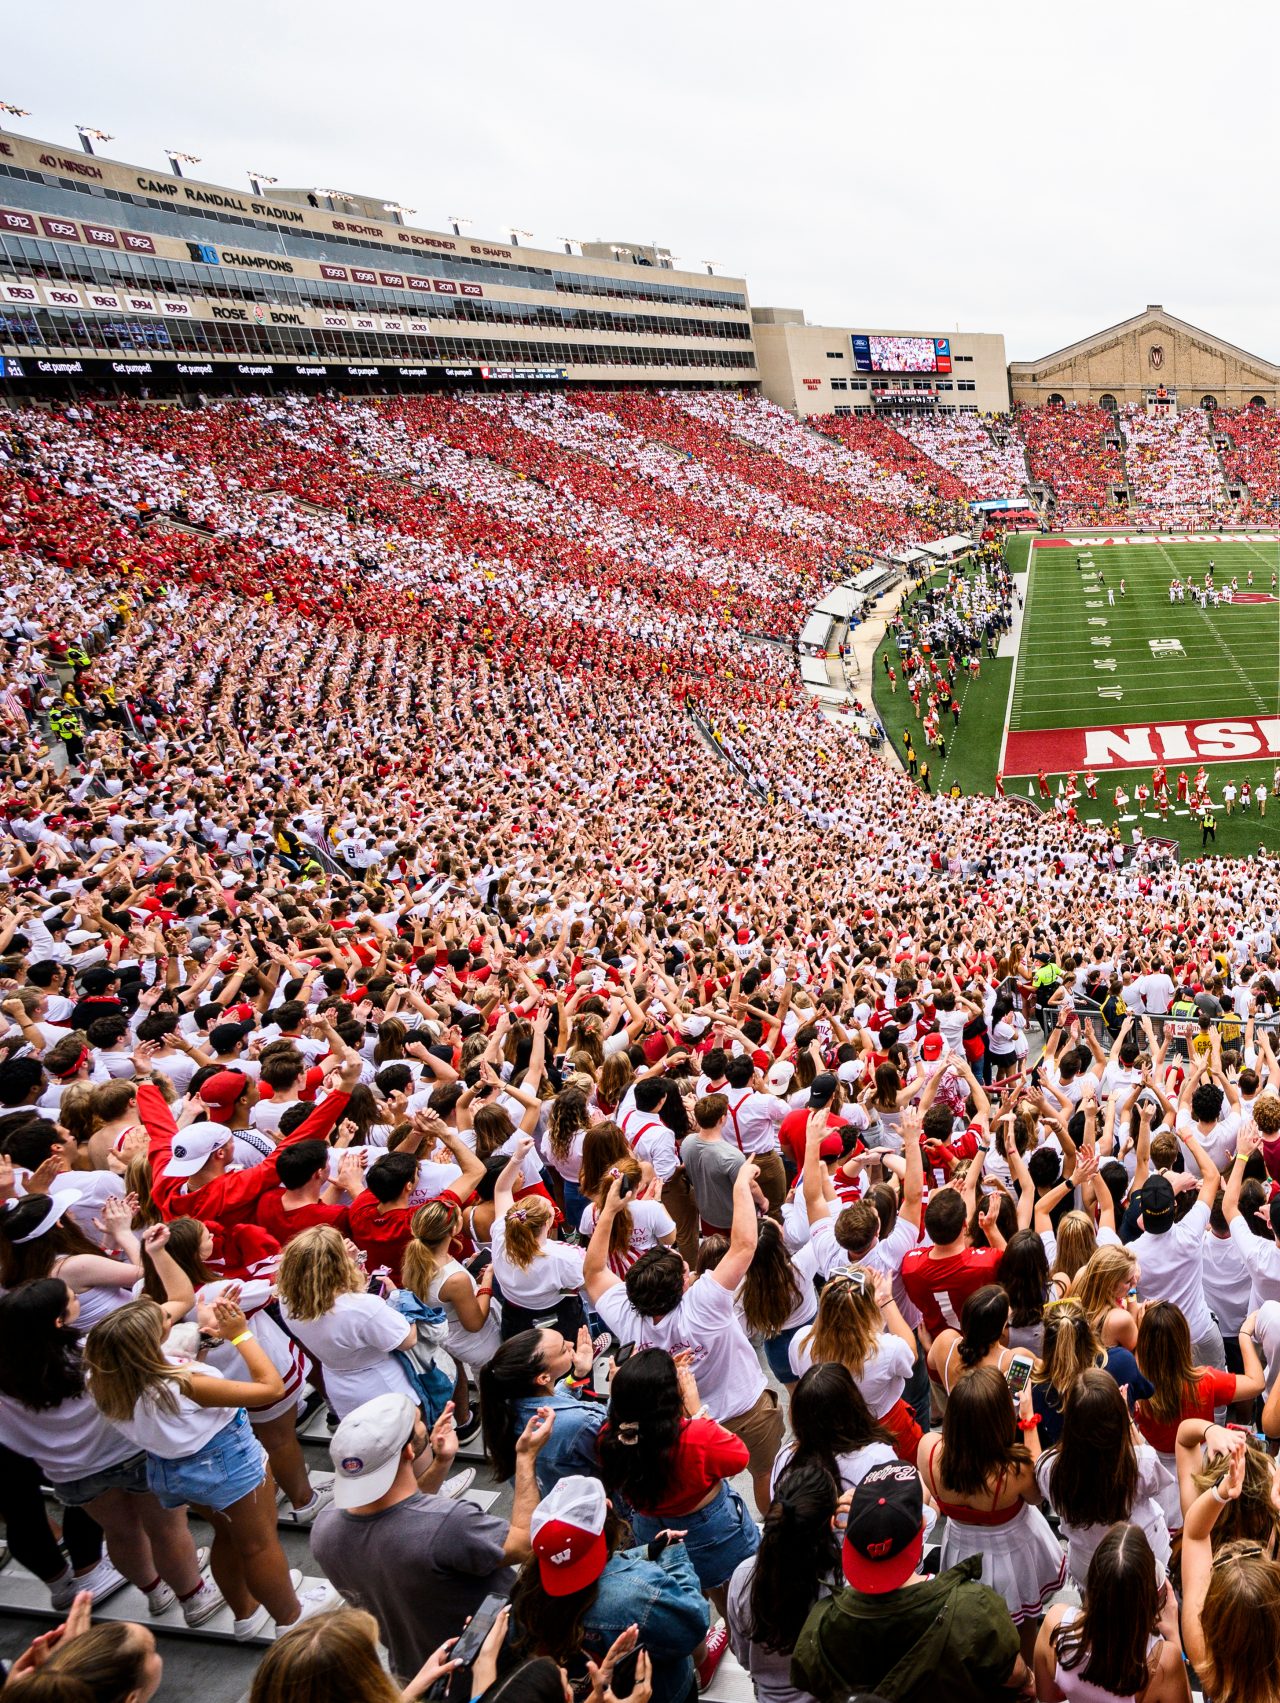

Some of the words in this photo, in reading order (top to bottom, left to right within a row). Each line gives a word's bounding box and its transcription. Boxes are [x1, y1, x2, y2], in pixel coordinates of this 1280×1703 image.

[57, 157, 103, 180] HIRSCH
[137, 177, 178, 196] CAMP
[184, 187, 247, 212] RANDALL
[251, 203, 303, 223] STADIUM
[4, 214, 32, 229] 1912
[48, 221, 77, 237] 1952
[346, 222, 384, 239] RICHTER
[127, 236, 152, 250] 1962
[411, 235, 457, 252] SCHREINER
[482, 247, 512, 261] SHAFER
[222, 252, 294, 274] CHAMPIONS
[325, 267, 346, 278] 1993
[383, 275, 403, 285] 1999
[410, 279, 429, 289] 2010
[6, 286, 35, 300] 1953
[437, 282, 454, 292] 2011
[464, 286, 480, 295] 2012
[50, 290, 79, 305] 1960
[92, 295, 118, 308] 1963
[130, 299, 153, 311] 1994
[165, 302, 188, 315] 1999
[212, 306, 248, 321] ROSE
[270, 311, 305, 325] BOWL
[324, 316, 347, 327] 2000
[357, 319, 374, 329] 2011
[384, 322, 402, 331] 2012
[411, 324, 428, 333] 2013
[38, 360, 52, 371] Get
[53, 361, 83, 375] pumped!
[113, 362, 126, 372] Get
[177, 363, 190, 373] Get
[1097, 685, 1124, 698] 10
[348, 848, 356, 859] 5
[933, 1290, 962, 1331] 1
[550, 1548, 572, 1565] W
